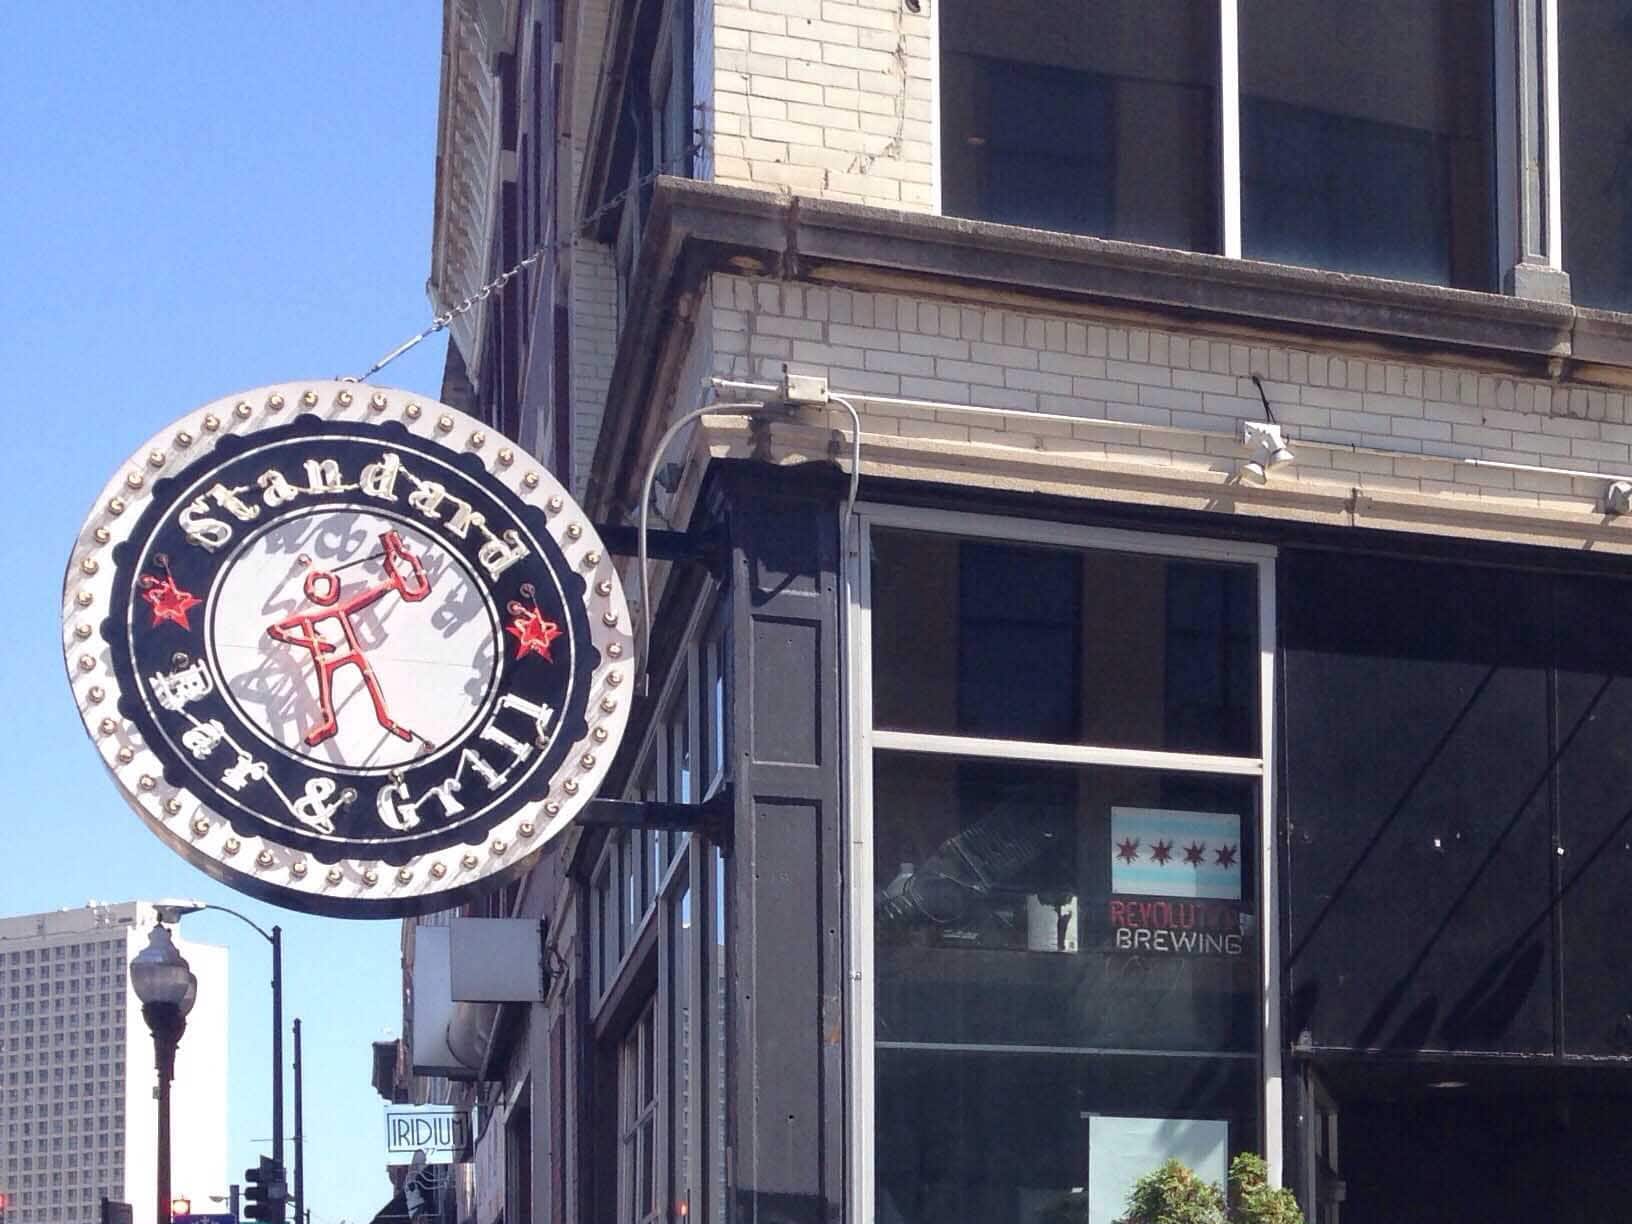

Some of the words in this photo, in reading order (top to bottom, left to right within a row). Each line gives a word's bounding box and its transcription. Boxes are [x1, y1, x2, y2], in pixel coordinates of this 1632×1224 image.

[179, 452, 532, 583] Standard
[148, 657, 269, 789] Bar
[1109, 900, 1239, 929] REVOLUT
[1116, 927, 1243, 955] BREWING
[392, 1118, 465, 1146] IRIDIUM
